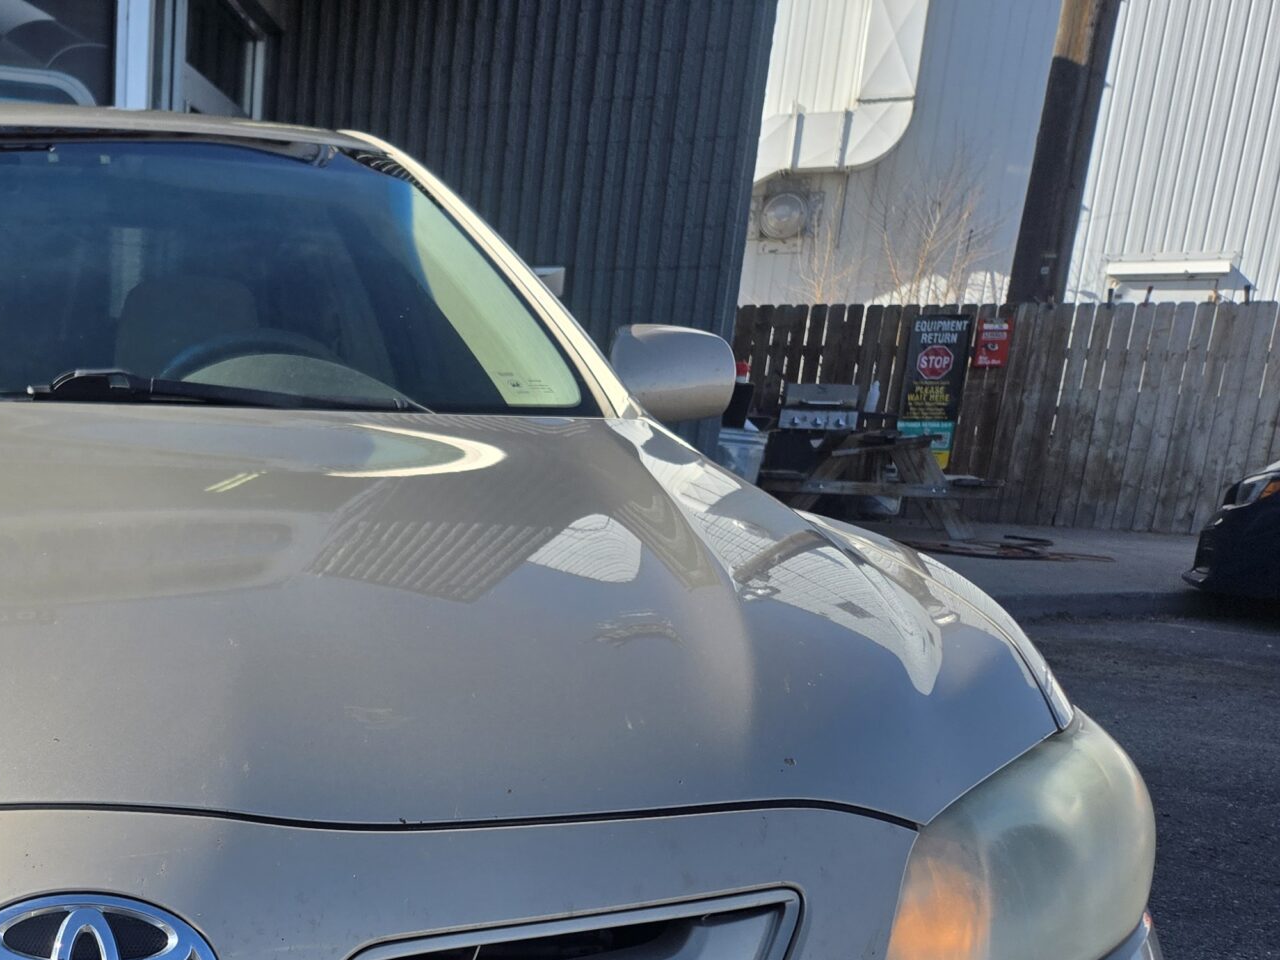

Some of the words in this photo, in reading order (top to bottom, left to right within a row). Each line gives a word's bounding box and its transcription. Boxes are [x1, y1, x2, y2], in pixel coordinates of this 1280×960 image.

[914, 320, 969, 332] EQUIPMENT
[920, 332, 958, 344] RETURN
[919, 355, 950, 369] STOP
